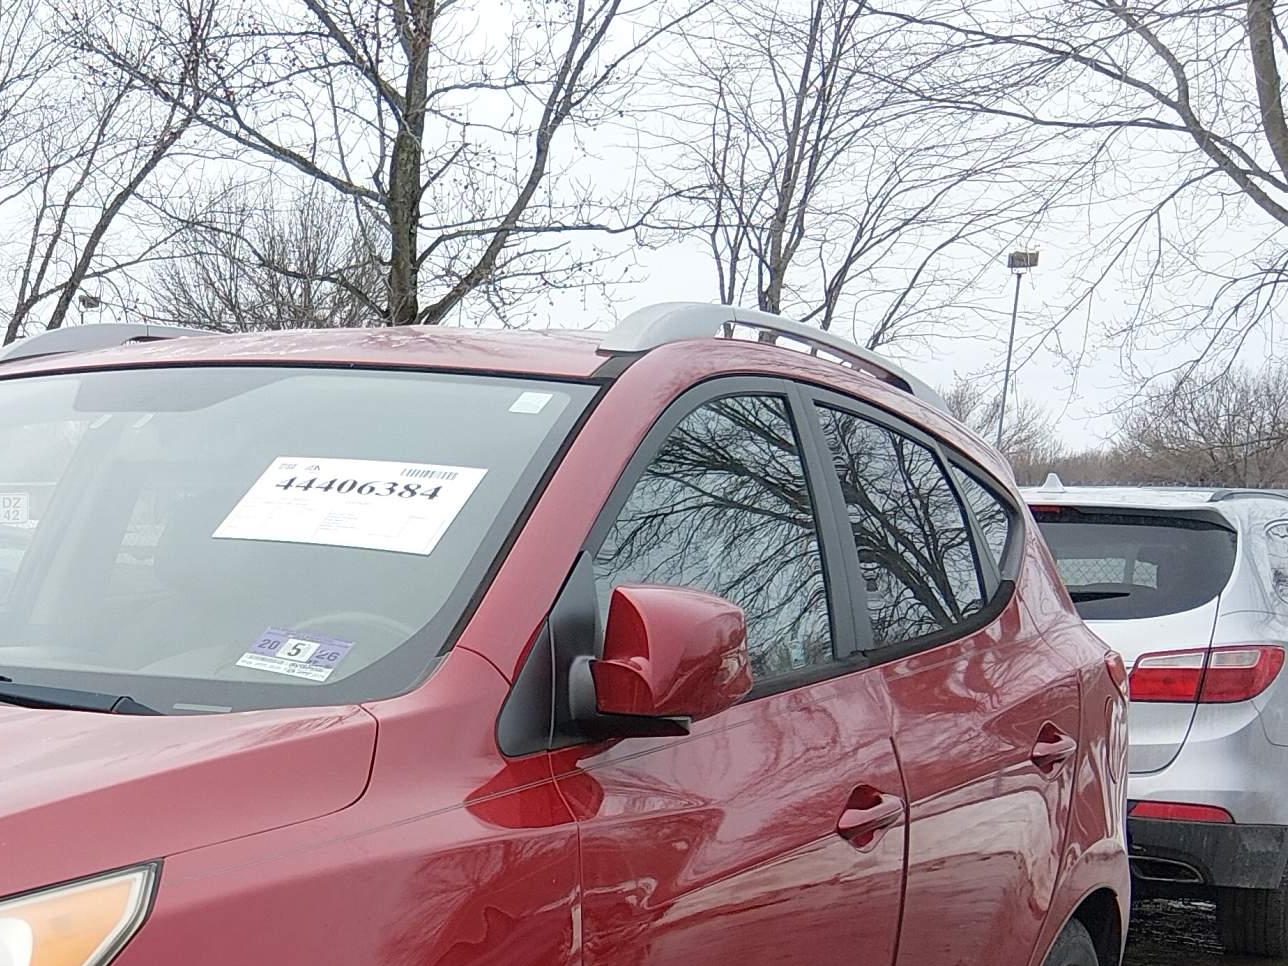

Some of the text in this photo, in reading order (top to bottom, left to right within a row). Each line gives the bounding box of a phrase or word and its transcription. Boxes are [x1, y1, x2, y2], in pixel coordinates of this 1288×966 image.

[275, 476, 444, 500] 44406384
[2, 497, 21, 508] DZ
[3, 510, 20, 521] 42
[257, 638, 340, 662] 20 5 26
